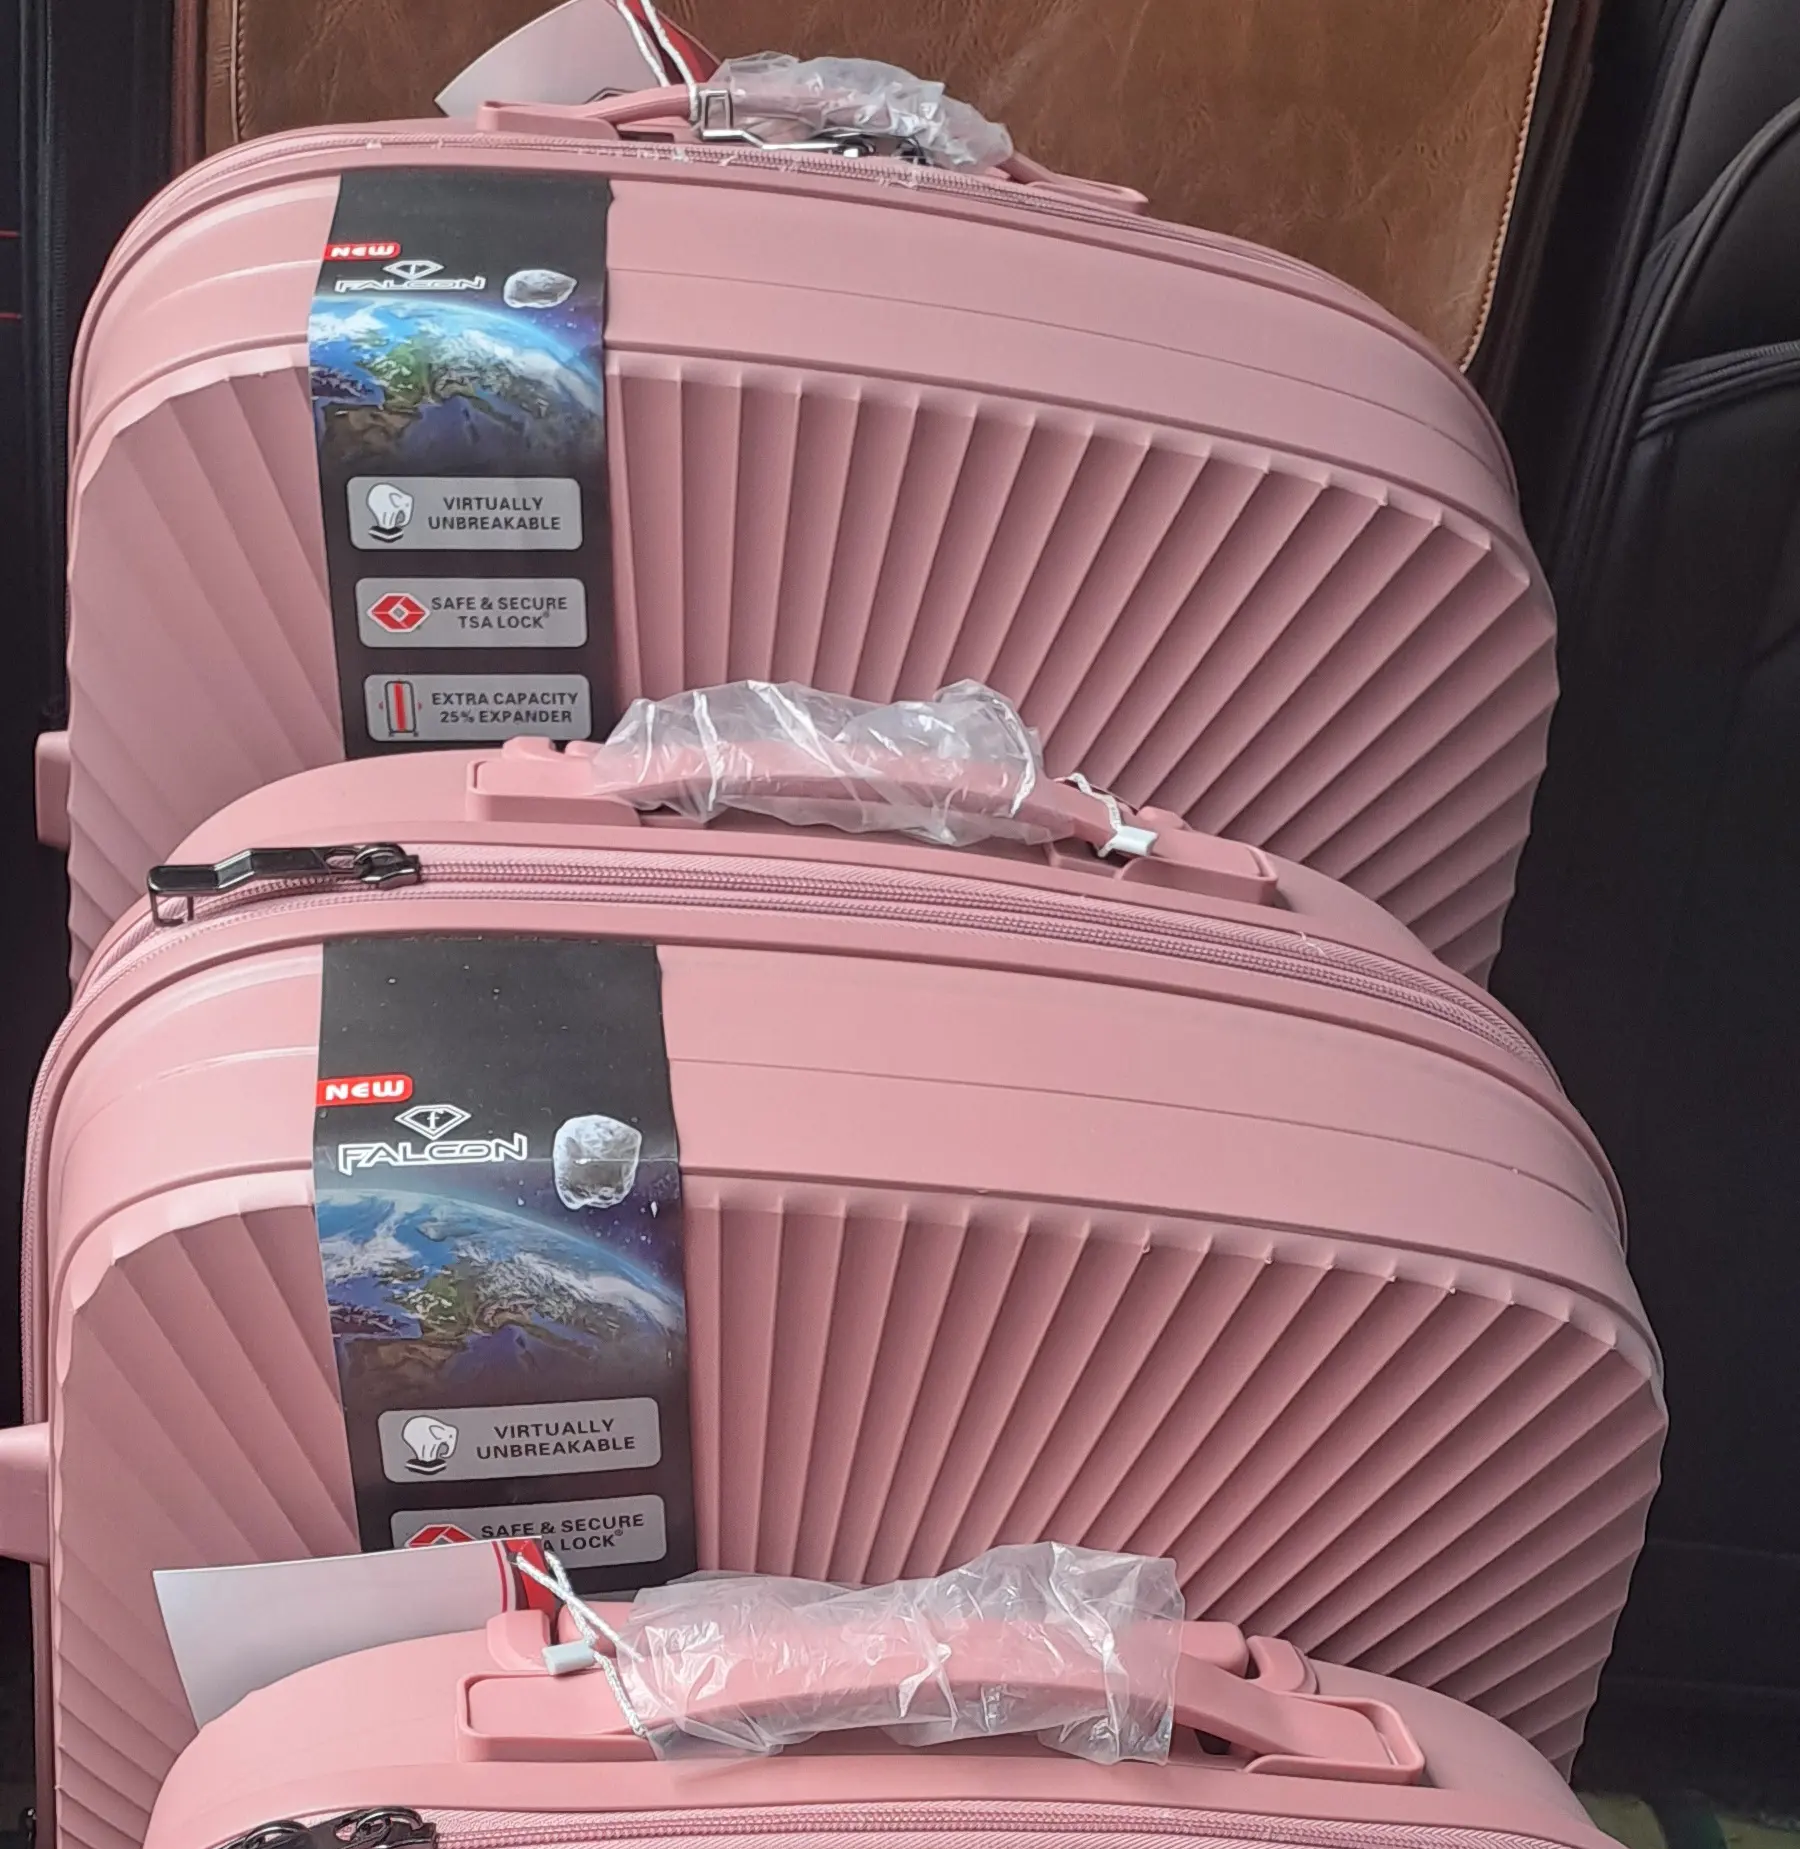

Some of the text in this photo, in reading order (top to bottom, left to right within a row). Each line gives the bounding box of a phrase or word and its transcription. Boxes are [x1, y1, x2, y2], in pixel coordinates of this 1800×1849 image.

[331, 244, 395, 257] NEW
[335, 276, 486, 292] FALCON
[443, 497, 543, 511] VIRTUALLY
[428, 516, 561, 531] UNBREAKABLE
[431, 597, 568, 611] SAFE & SECURE
[458, 615, 493, 629] TSA
[432, 692, 579, 706] EXTRA CAPACITY
[440, 710, 572, 723] 25% EXPANDER
[325, 1080, 405, 1100] NEW
[339, 1133, 527, 1176] FALCON
[493, 1418, 615, 1439] VIRTUALLY
[476, 1436, 636, 1460] UNBREAKABLE
[481, 1513, 644, 1538] SAFE & SECURE
